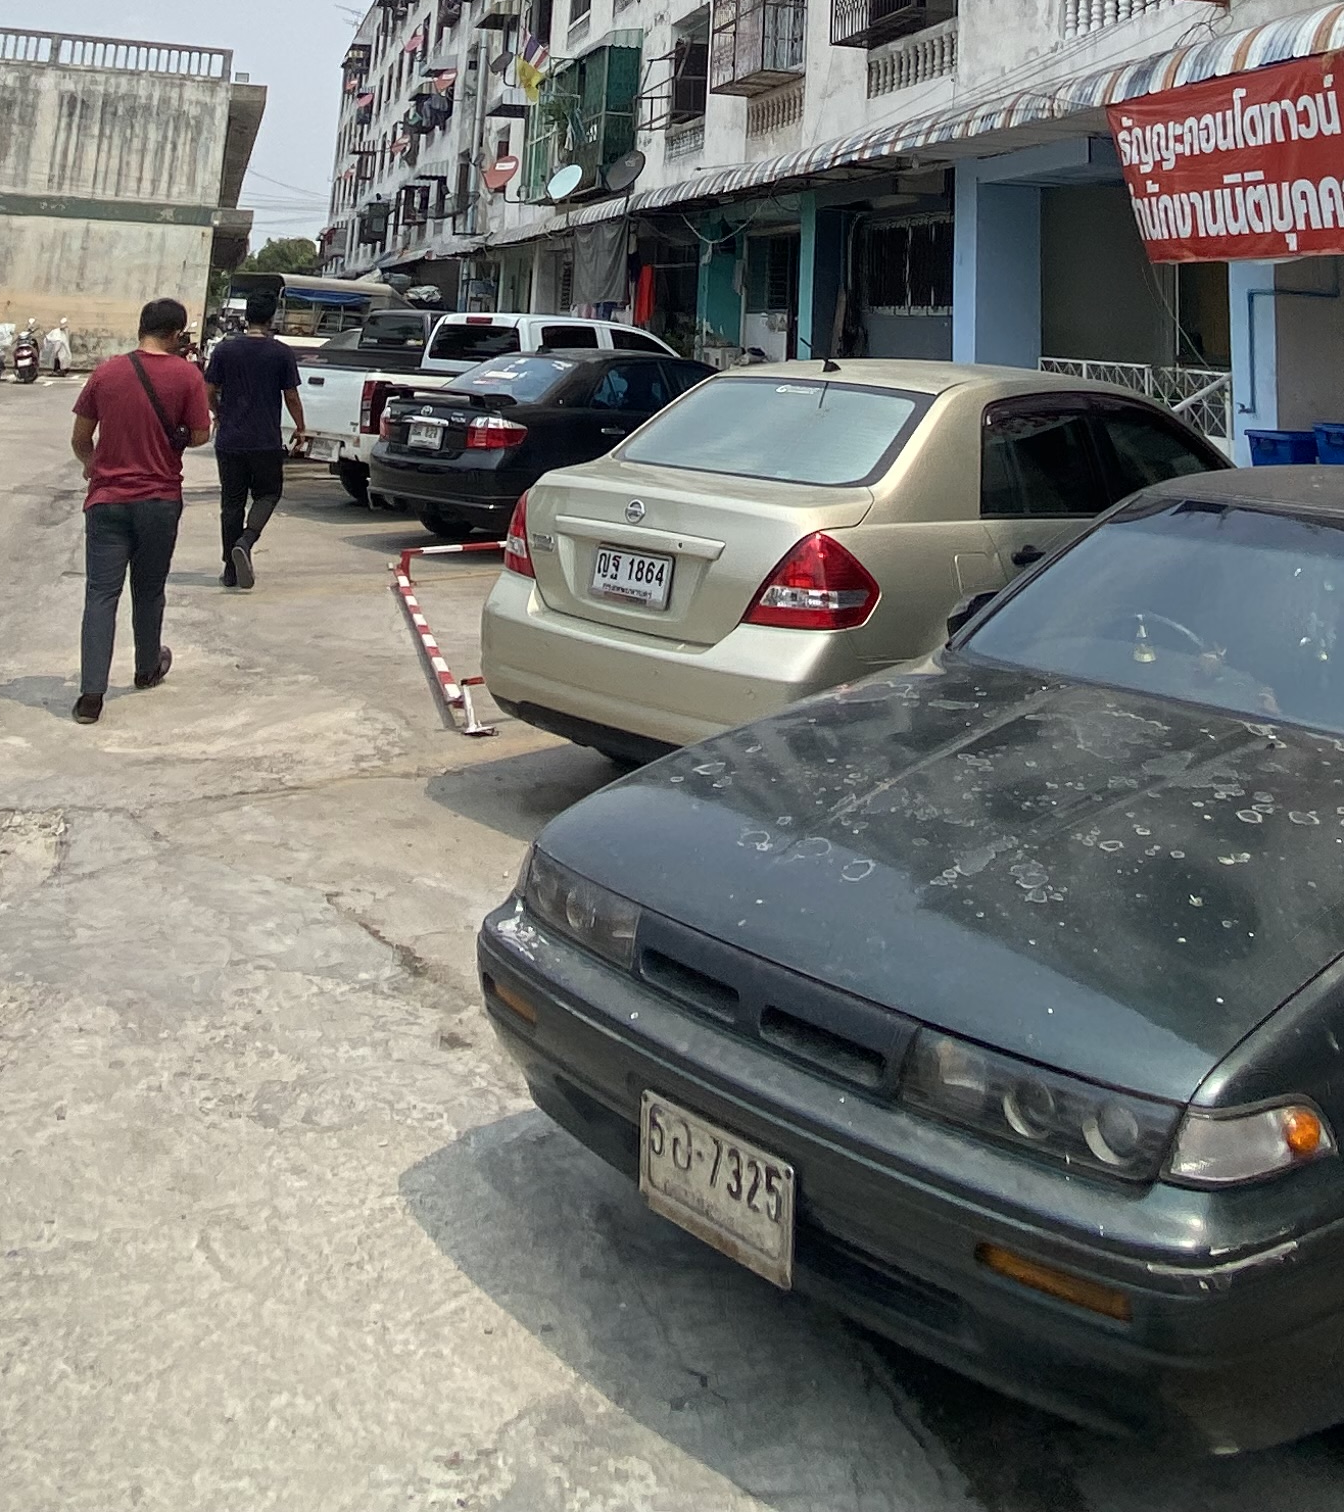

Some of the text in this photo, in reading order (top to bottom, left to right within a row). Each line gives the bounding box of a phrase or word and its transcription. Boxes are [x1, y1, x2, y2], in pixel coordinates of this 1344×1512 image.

[1117, 74, 1341, 173] ธัญญะคอนโดทาวน์
[628, 557, 665, 587] 1864
